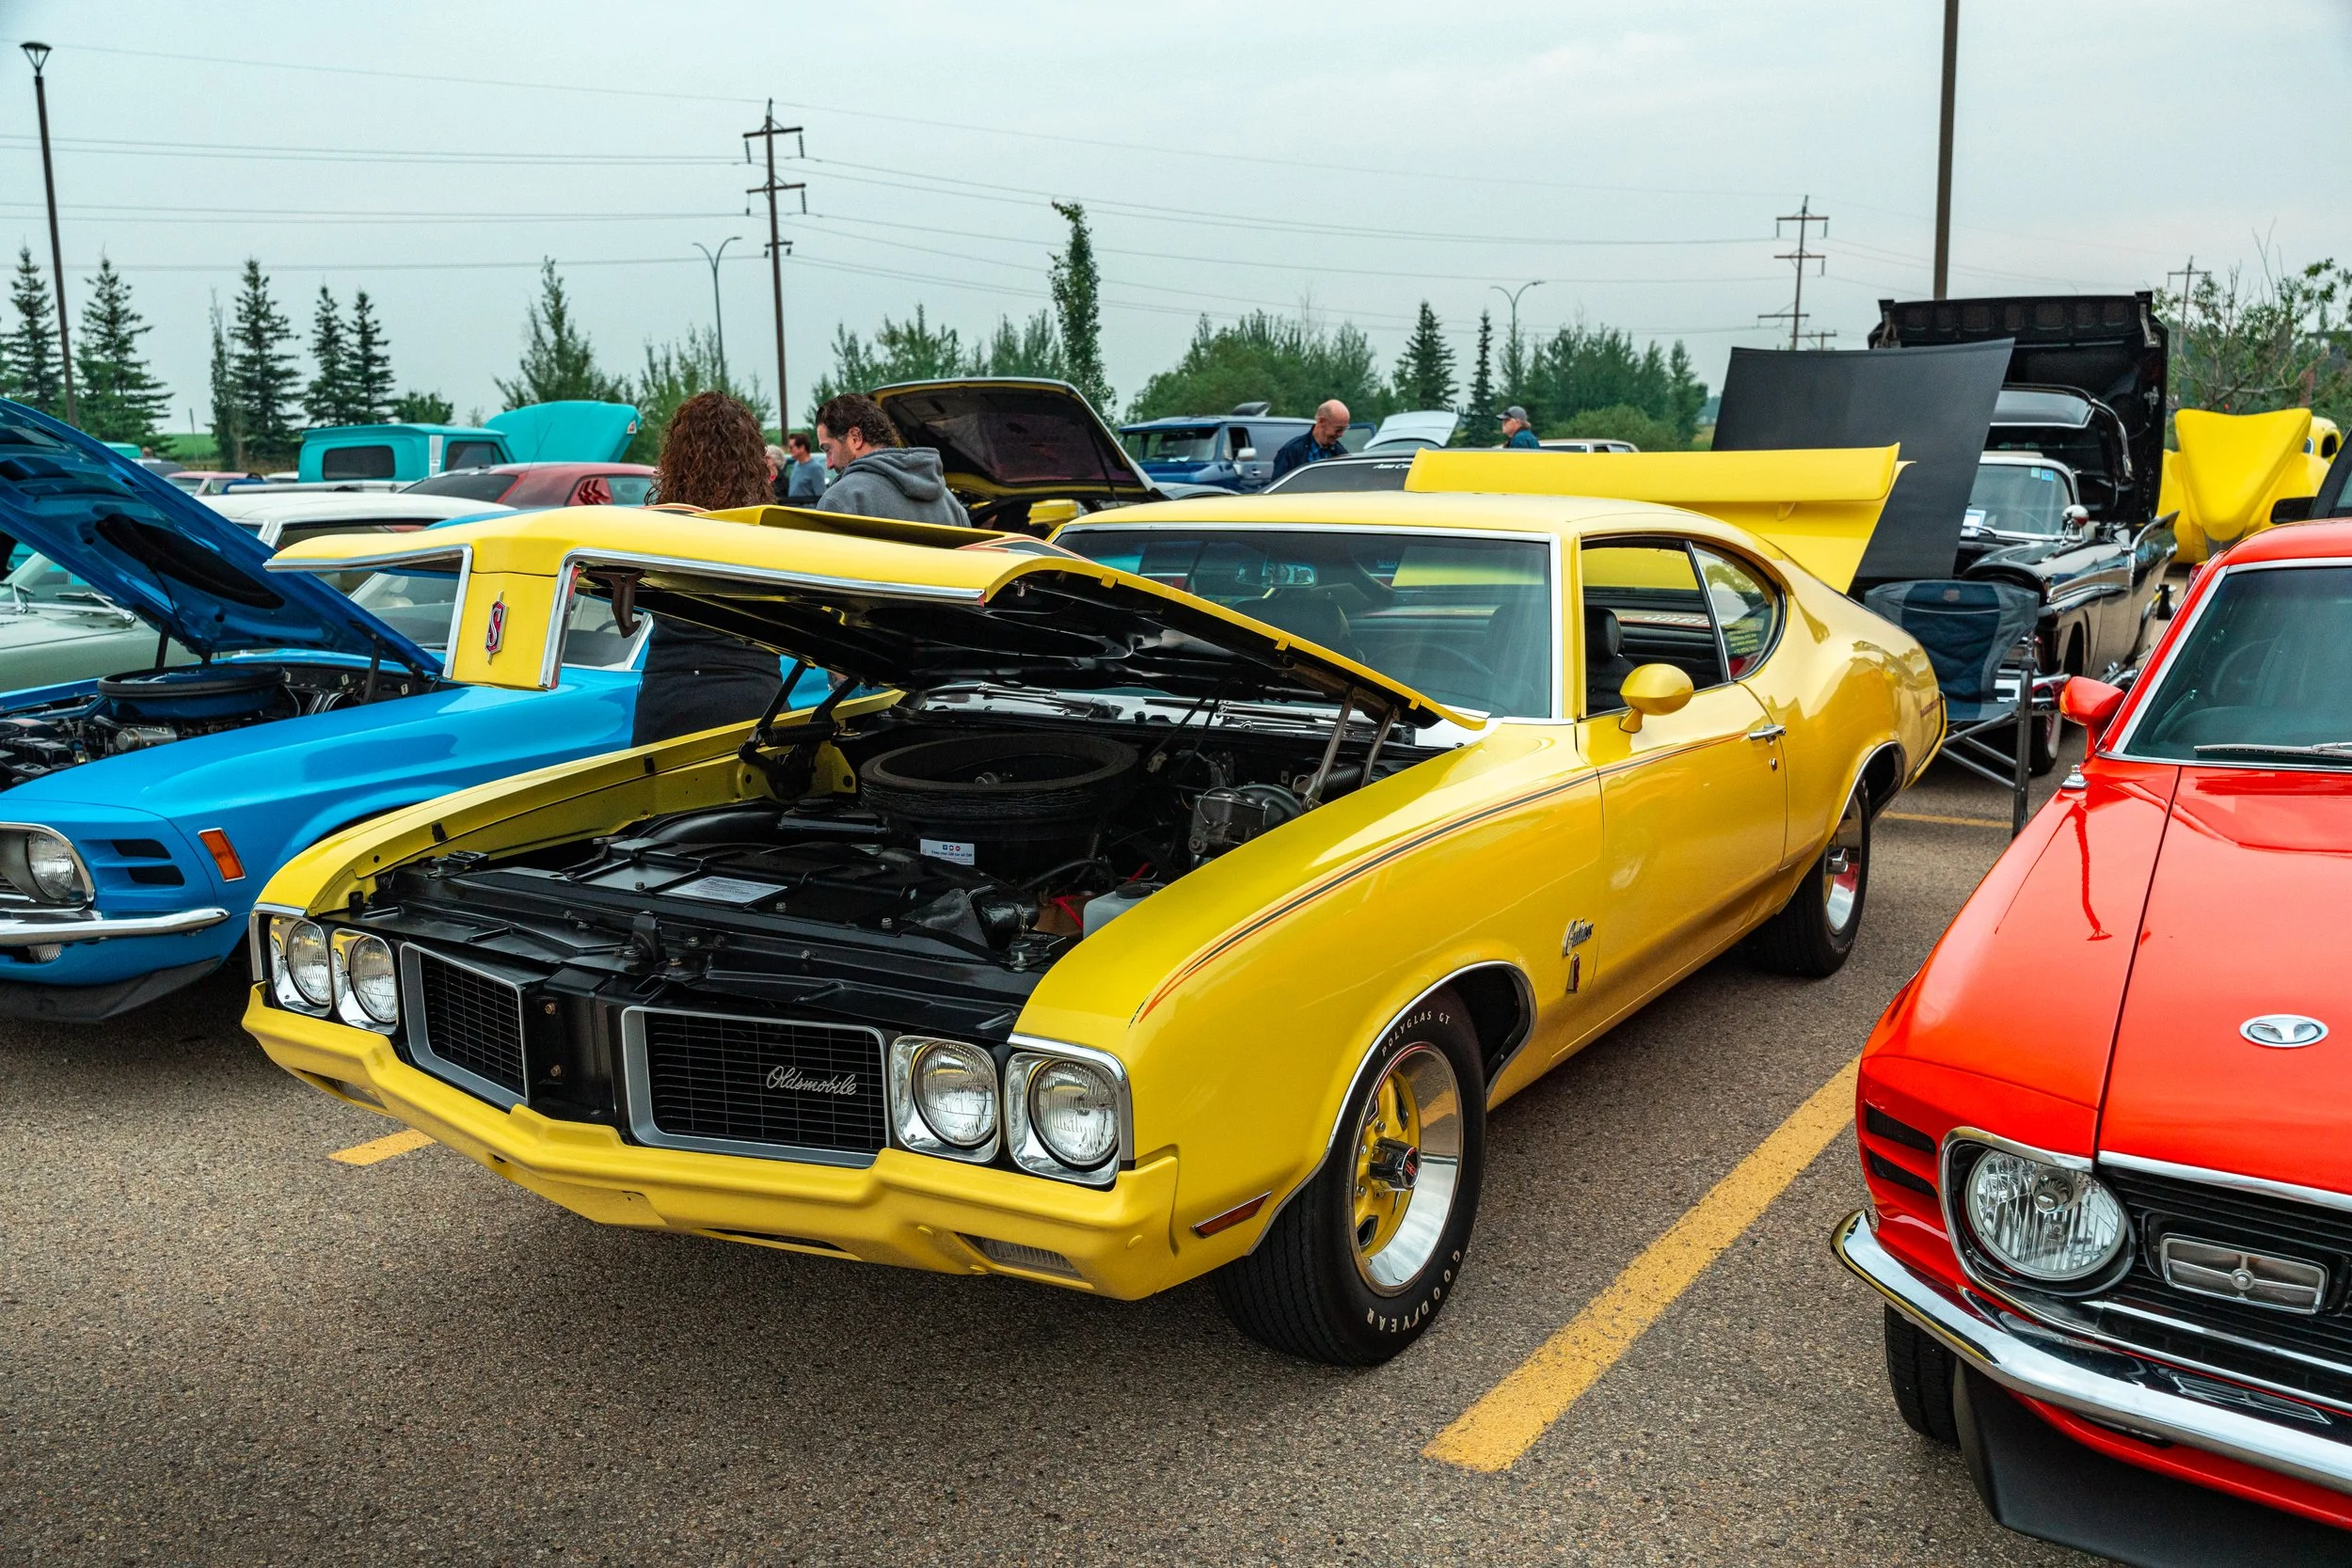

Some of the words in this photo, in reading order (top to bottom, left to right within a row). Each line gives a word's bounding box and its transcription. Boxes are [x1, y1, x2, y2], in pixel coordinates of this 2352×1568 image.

[1381, 1010, 1432, 1057] POLYGLAS
[1438, 1012, 1451, 1025] GT
[766, 1066, 857, 1096] Oldsmobile
[1366, 1250, 1460, 1333] GOODYEAR
